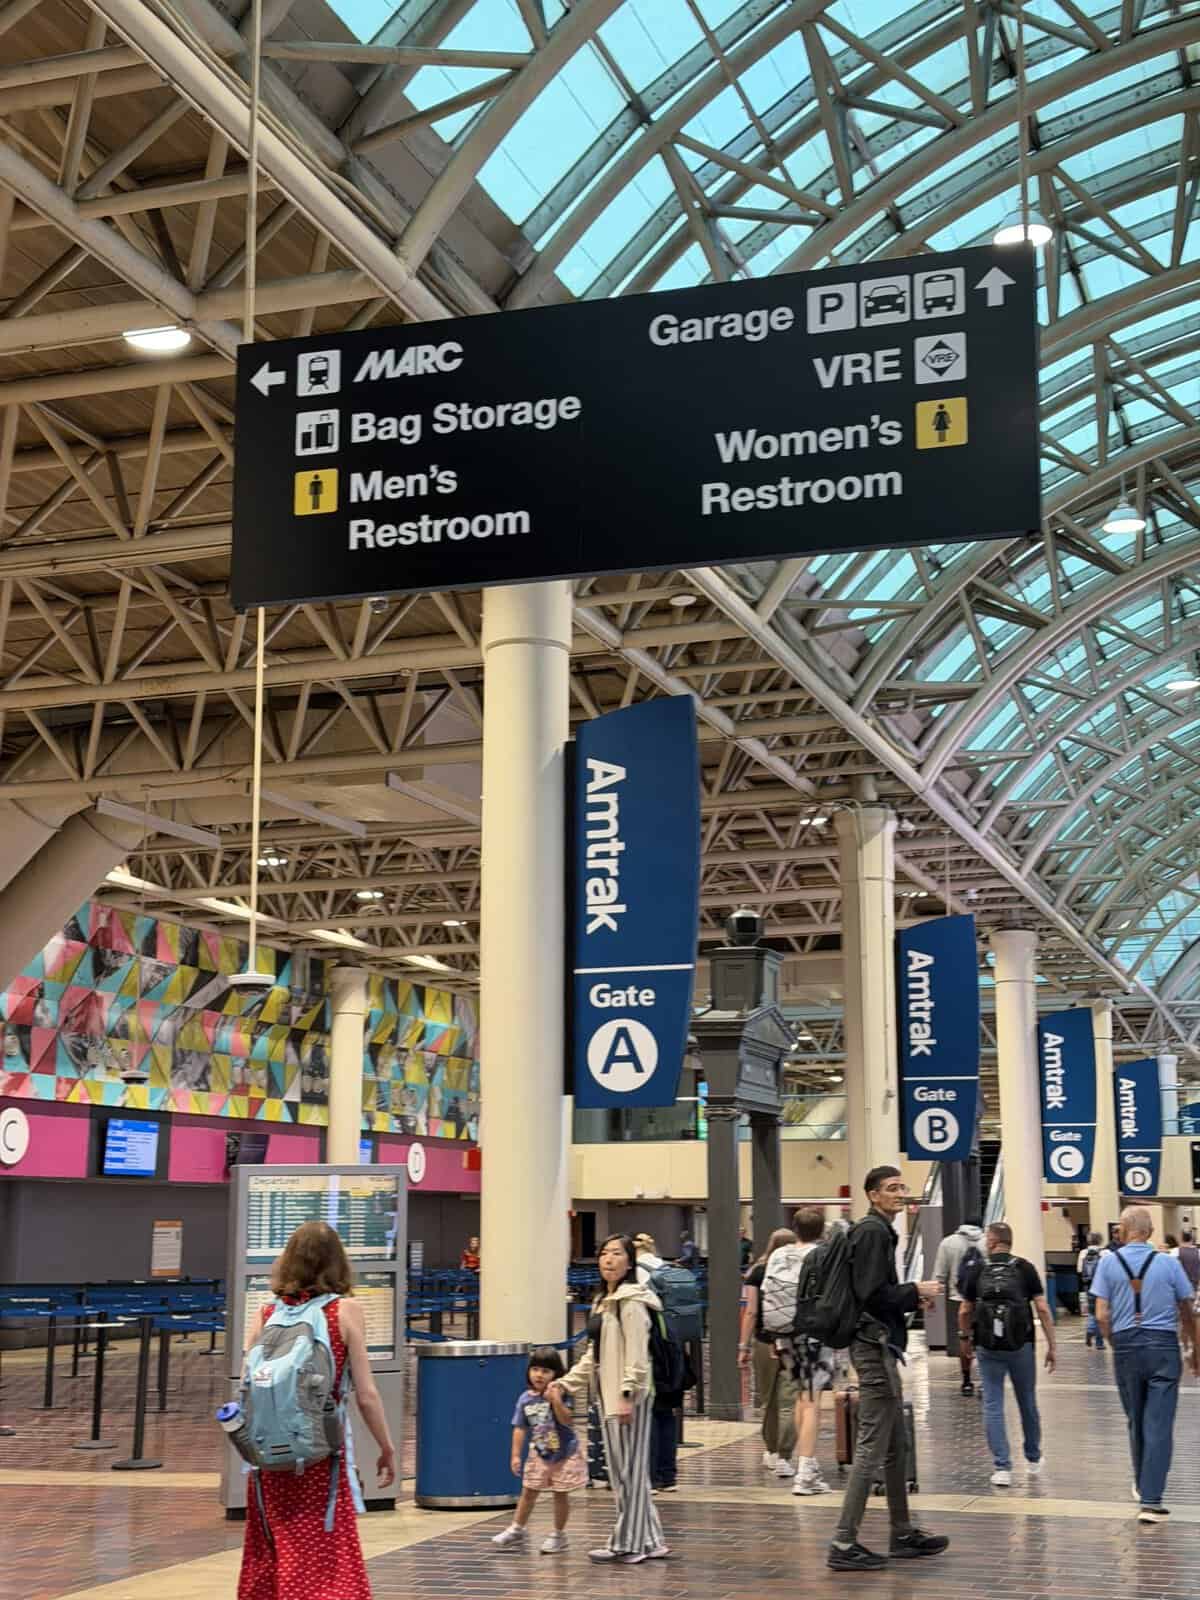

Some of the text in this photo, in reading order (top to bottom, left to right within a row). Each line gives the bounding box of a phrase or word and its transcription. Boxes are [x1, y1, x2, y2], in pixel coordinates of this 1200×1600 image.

[649, 293, 844, 345] Garage P
[354, 342, 463, 382] MARC
[813, 348, 902, 389] VRE
[352, 397, 582, 444] Bag Storage
[715, 415, 902, 463] Women’s
[350, 465, 457, 502] Men’s
[702, 472, 902, 514] Restroom
[349, 511, 529, 549] Restroom
[586, 758, 627, 934] Amtrak
[590, 983, 656, 1009] Gate
[907, 951, 937, 1057] Amtrak
[600, 1027, 644, 1074] A
[1043, 1032, 1067, 1110] Amtrak
[914, 1086, 957, 1102] Gate
[1119, 1078, 1139, 1139] Amtrak
[3, 1120, 18, 1152] C
[927, 1115, 949, 1145] B
[1057, 1151, 1073, 1172] C
[1132, 1171, 1146, 1187] D
